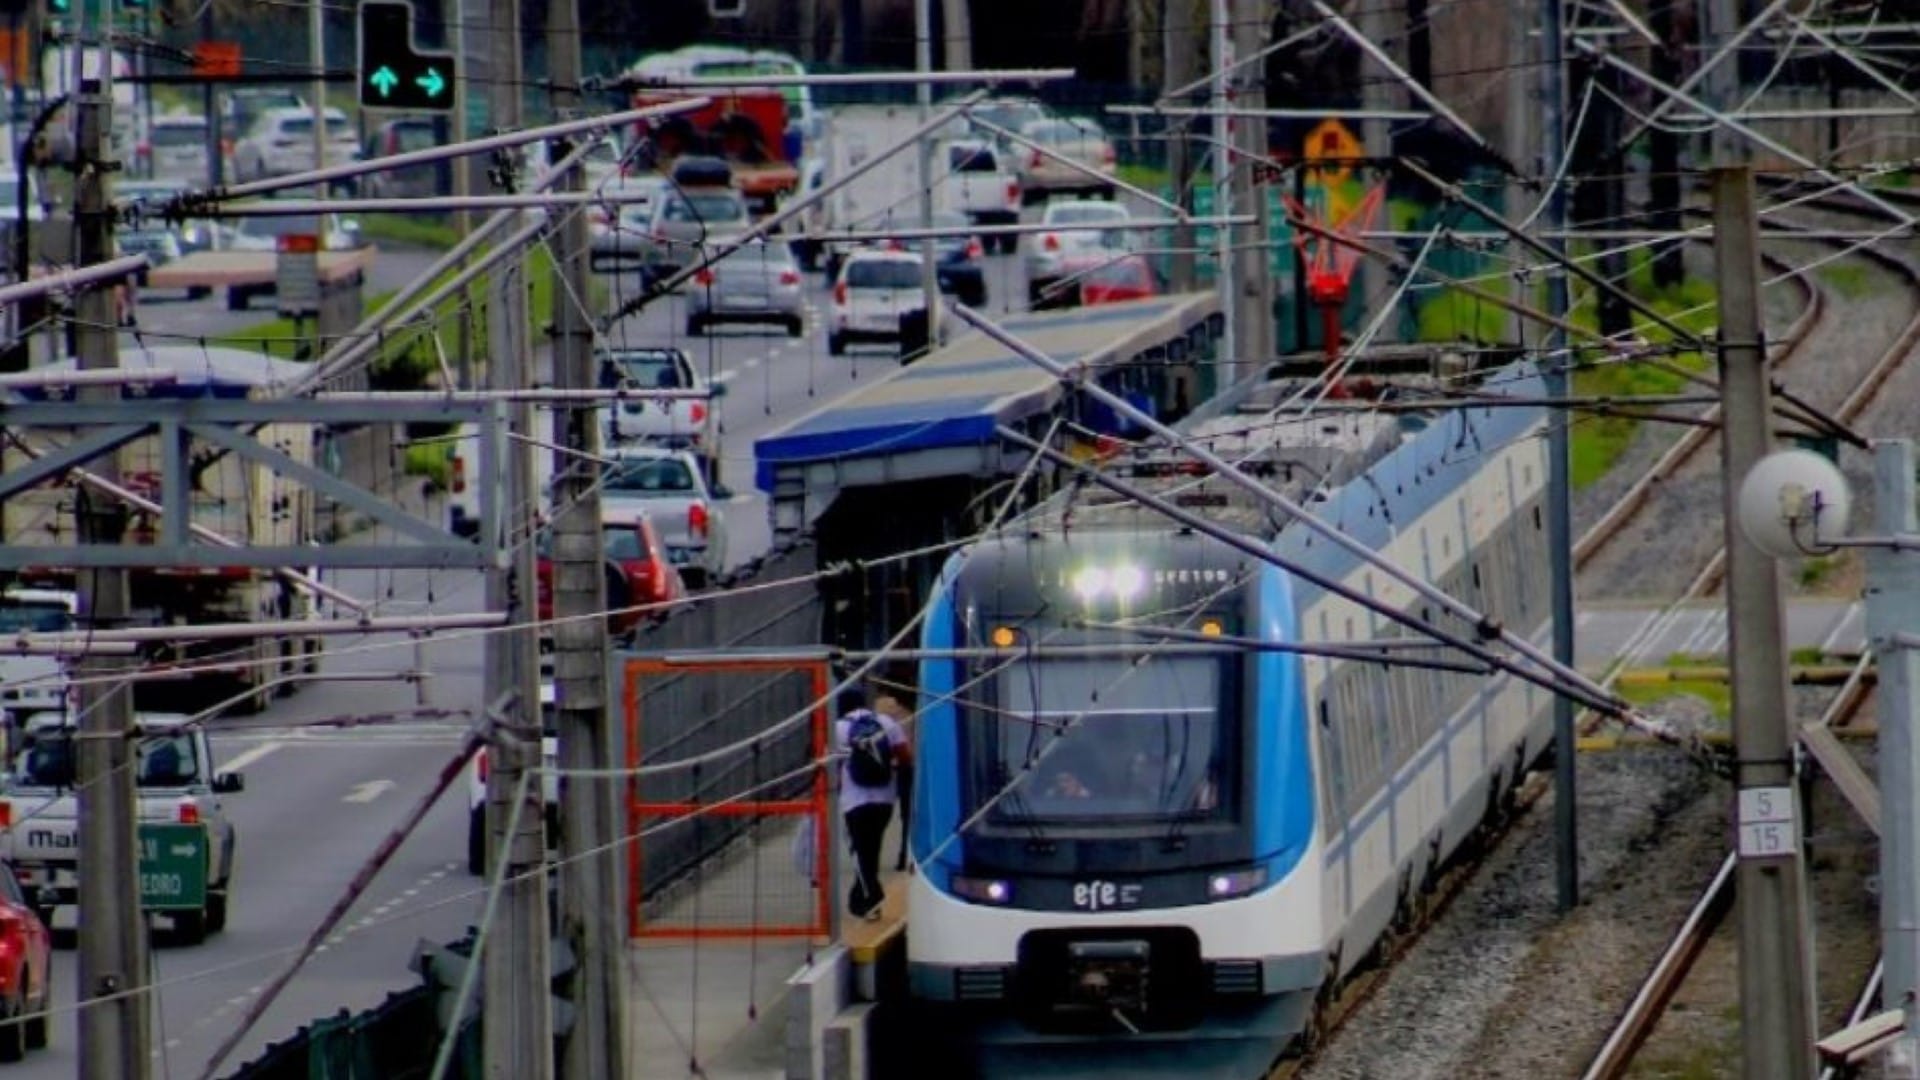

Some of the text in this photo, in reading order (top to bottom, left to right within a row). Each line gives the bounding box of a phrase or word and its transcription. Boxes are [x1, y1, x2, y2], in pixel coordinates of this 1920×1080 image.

[1758, 791, 1772, 816] 5
[1753, 826, 1779, 850] 15
[1074, 880, 1116, 909] efe
